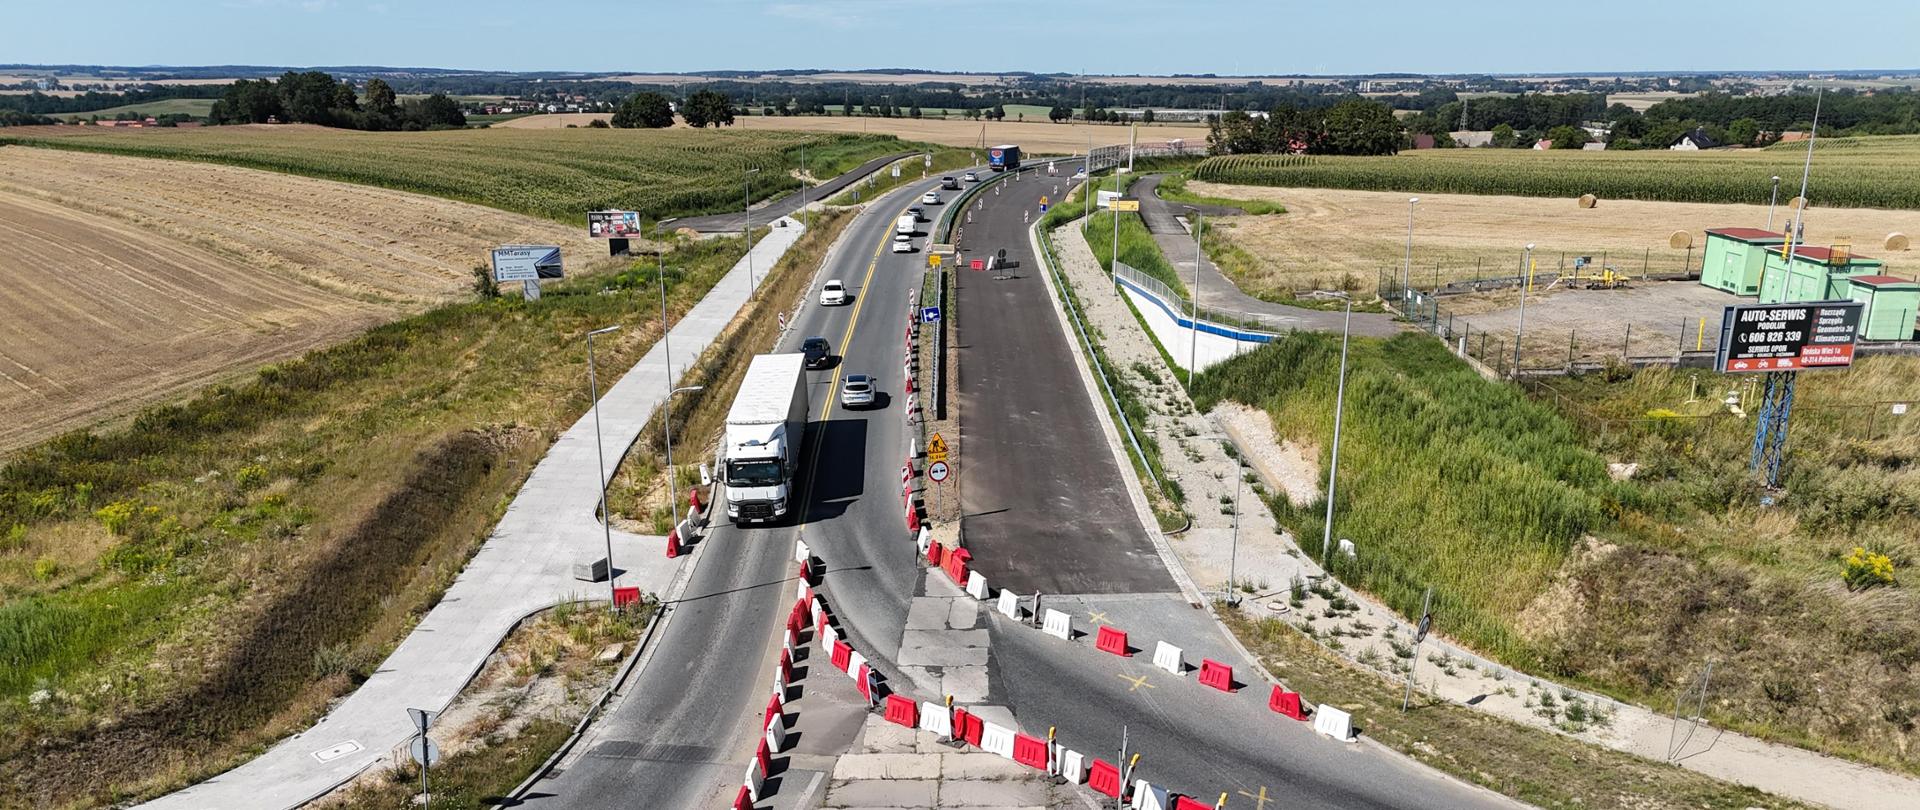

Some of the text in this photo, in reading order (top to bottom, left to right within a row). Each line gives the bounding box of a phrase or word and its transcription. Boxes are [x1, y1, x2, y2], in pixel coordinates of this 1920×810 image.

[1741, 309, 1806, 322] AUTO-SERWIS
[1757, 322, 1786, 330] PODOLUK
[1748, 331, 1801, 343] 606 826 339
[1748, 345, 1770, 353] SERWIS
